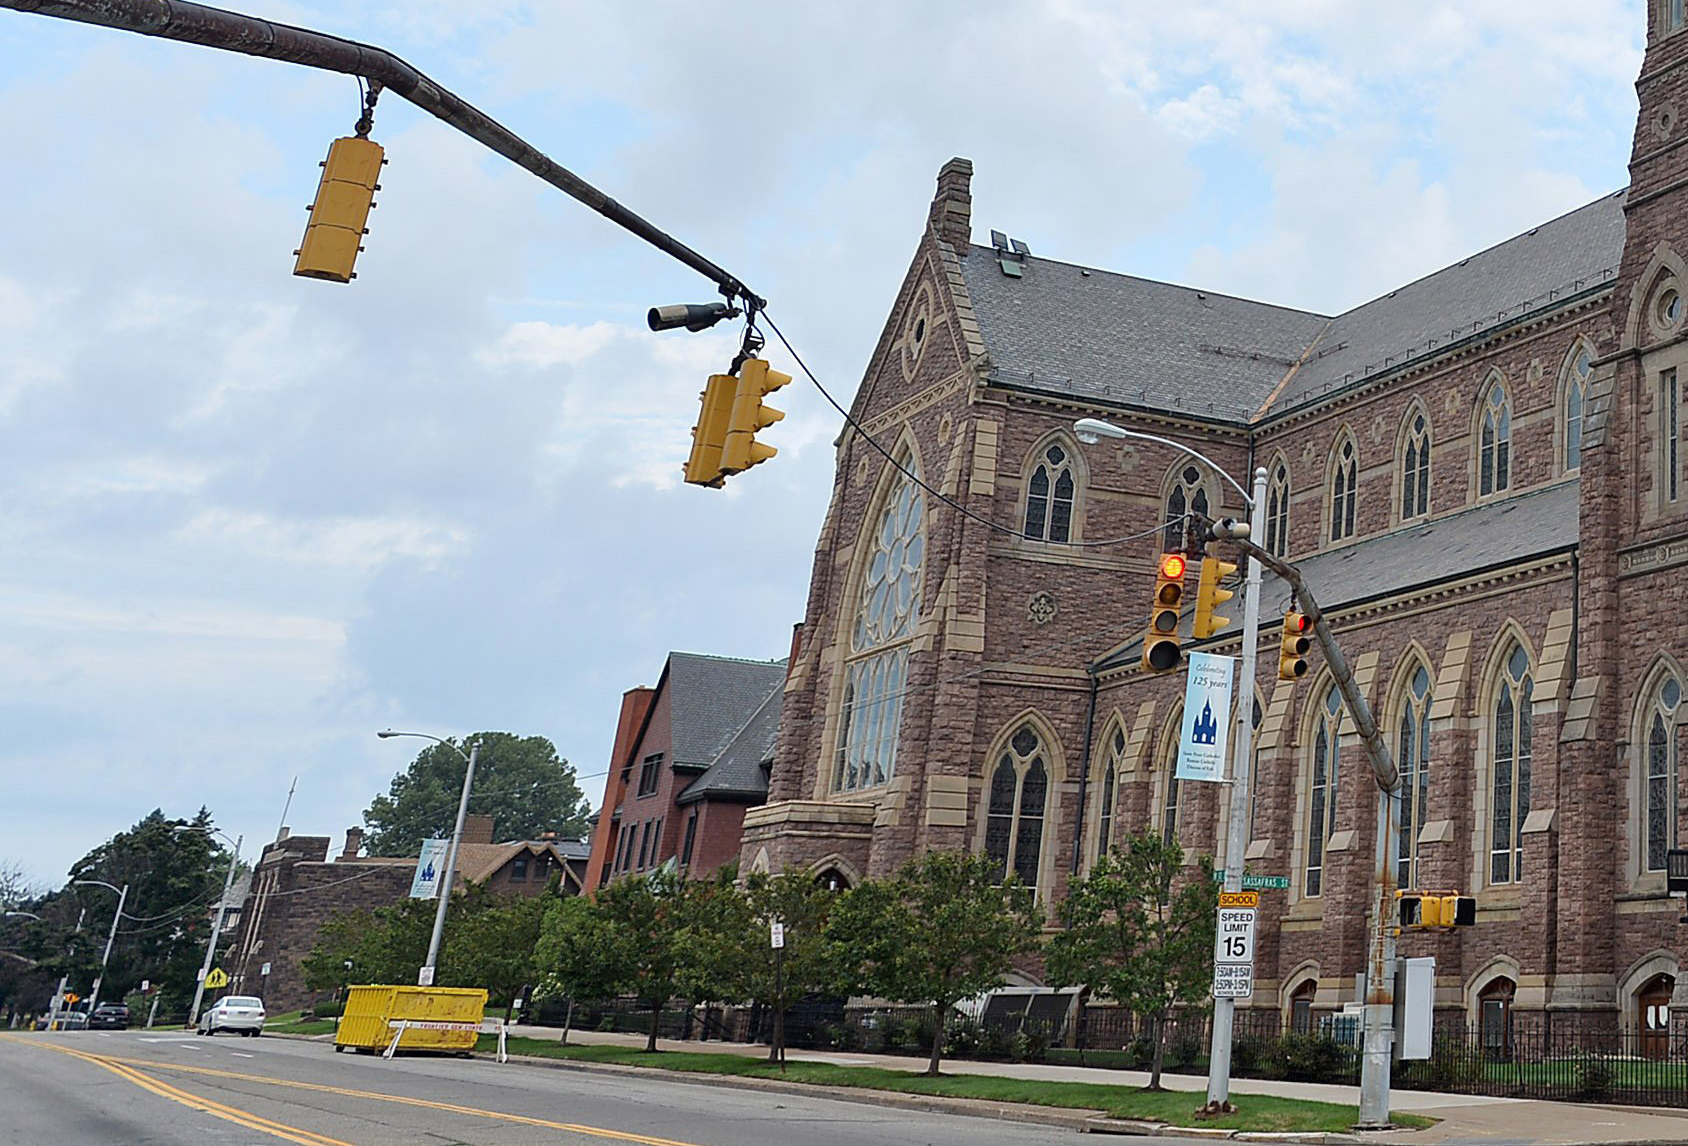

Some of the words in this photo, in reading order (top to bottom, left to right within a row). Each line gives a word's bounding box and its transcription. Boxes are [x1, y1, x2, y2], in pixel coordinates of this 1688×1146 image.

[1193, 676, 1208, 686] 125
[1208, 680, 1228, 690] years
[1243, 877, 1277, 887] SASSAFRAS
[1221, 895, 1254, 904] SCHOOL
[1221, 913, 1253, 922] SPEED
[1224, 923, 1249, 932] LIMIT
[1223, 937, 1246, 957] 15
